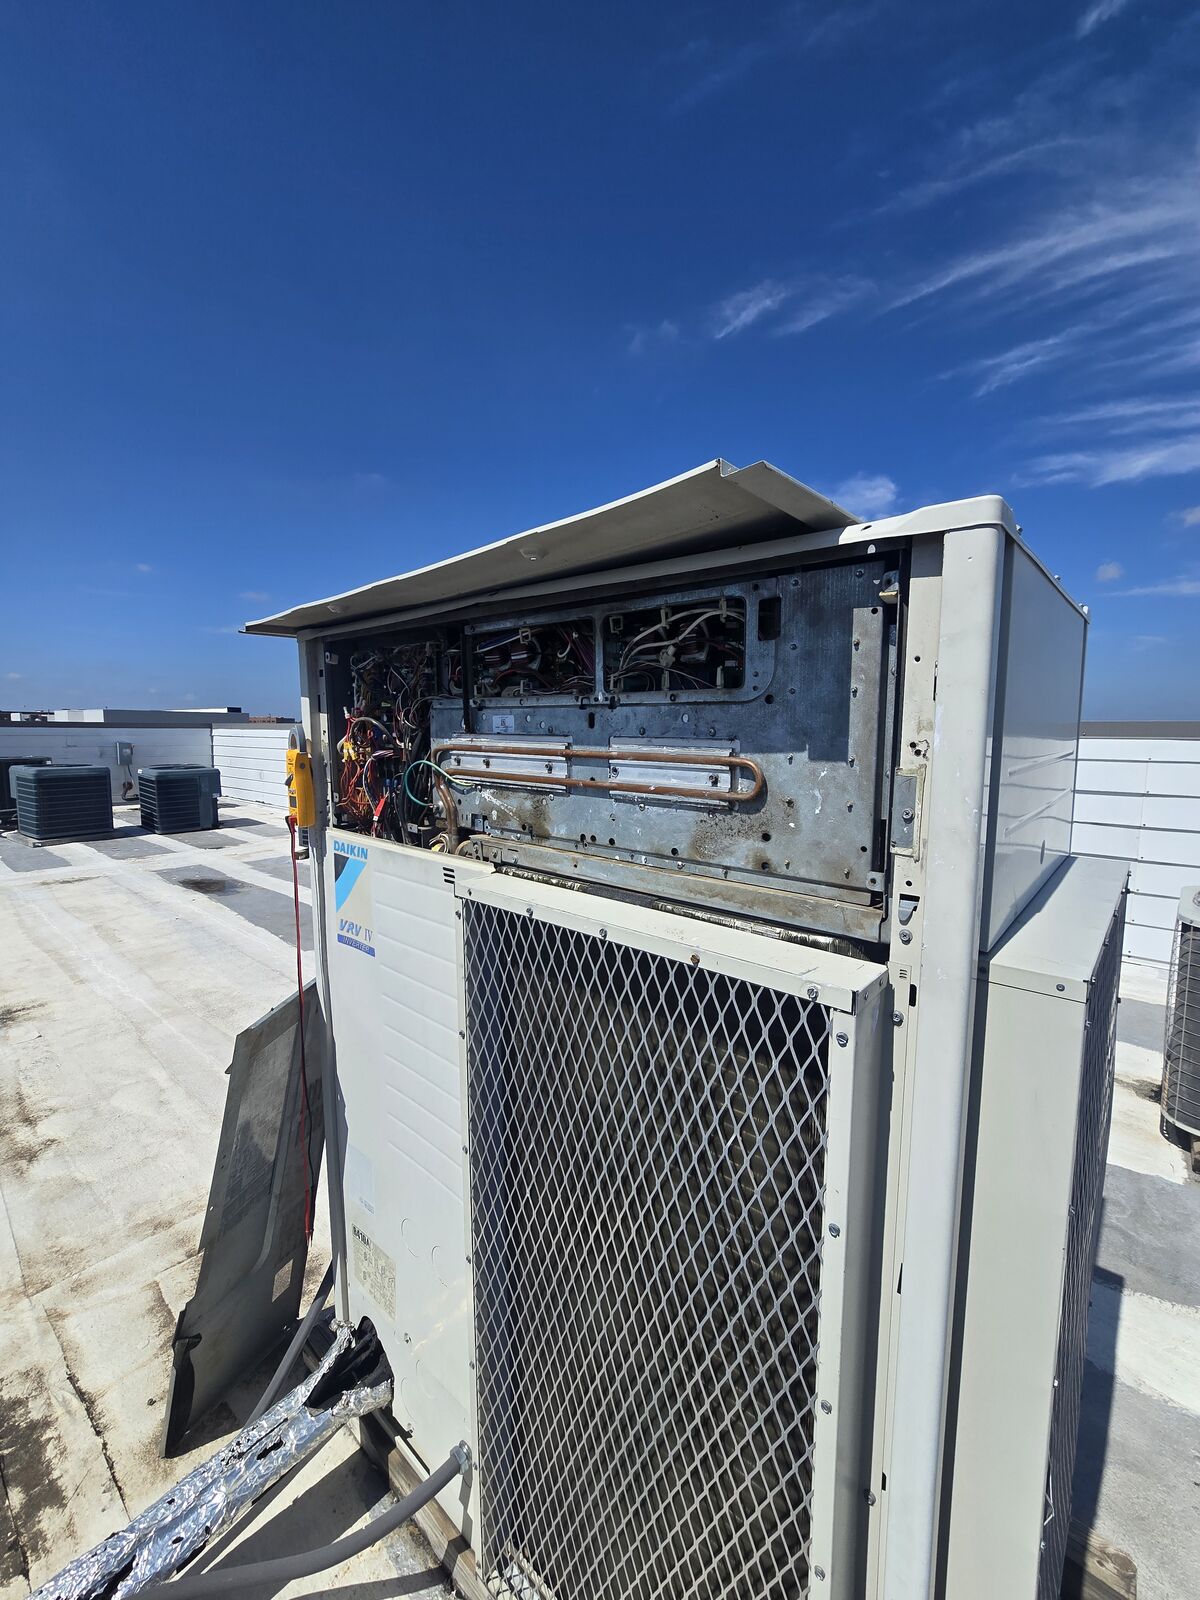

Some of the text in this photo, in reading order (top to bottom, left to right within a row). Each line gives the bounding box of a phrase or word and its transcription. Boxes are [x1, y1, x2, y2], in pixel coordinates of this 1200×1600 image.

[334, 840, 368, 860] DAIKIN
[339, 919, 361, 936] VRV
[343, 936, 370, 953] INVERTER
